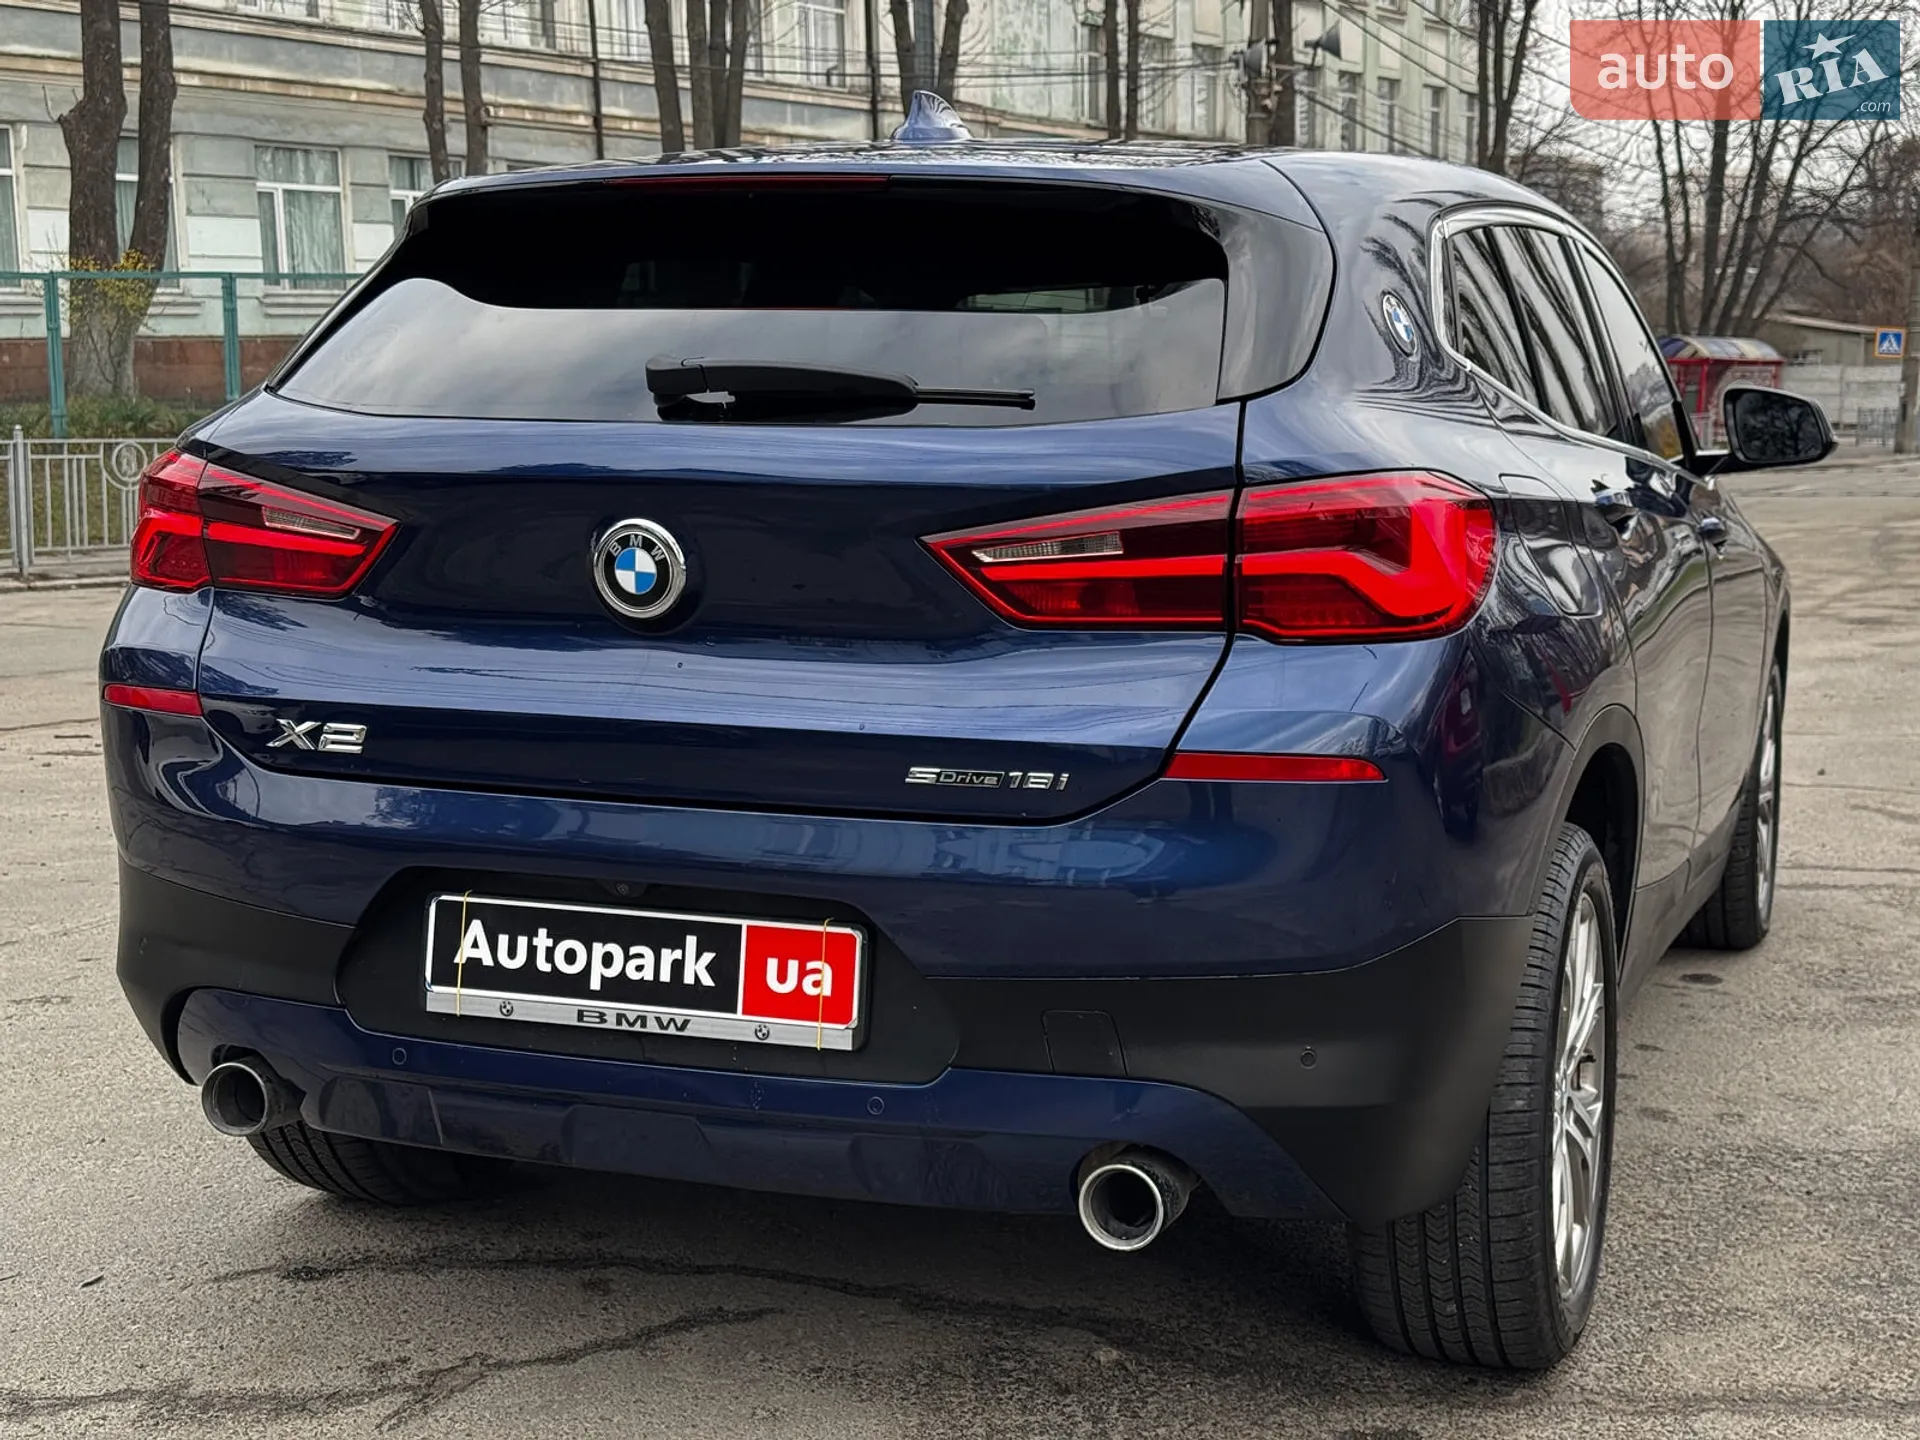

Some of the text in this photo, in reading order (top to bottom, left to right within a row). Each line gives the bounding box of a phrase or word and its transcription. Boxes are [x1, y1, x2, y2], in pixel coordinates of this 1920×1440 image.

[609, 534, 665, 562] BMW
[265, 719, 367, 754] X2
[454, 919, 833, 997] Autopark ua
[577, 1009, 691, 1033] BMW
